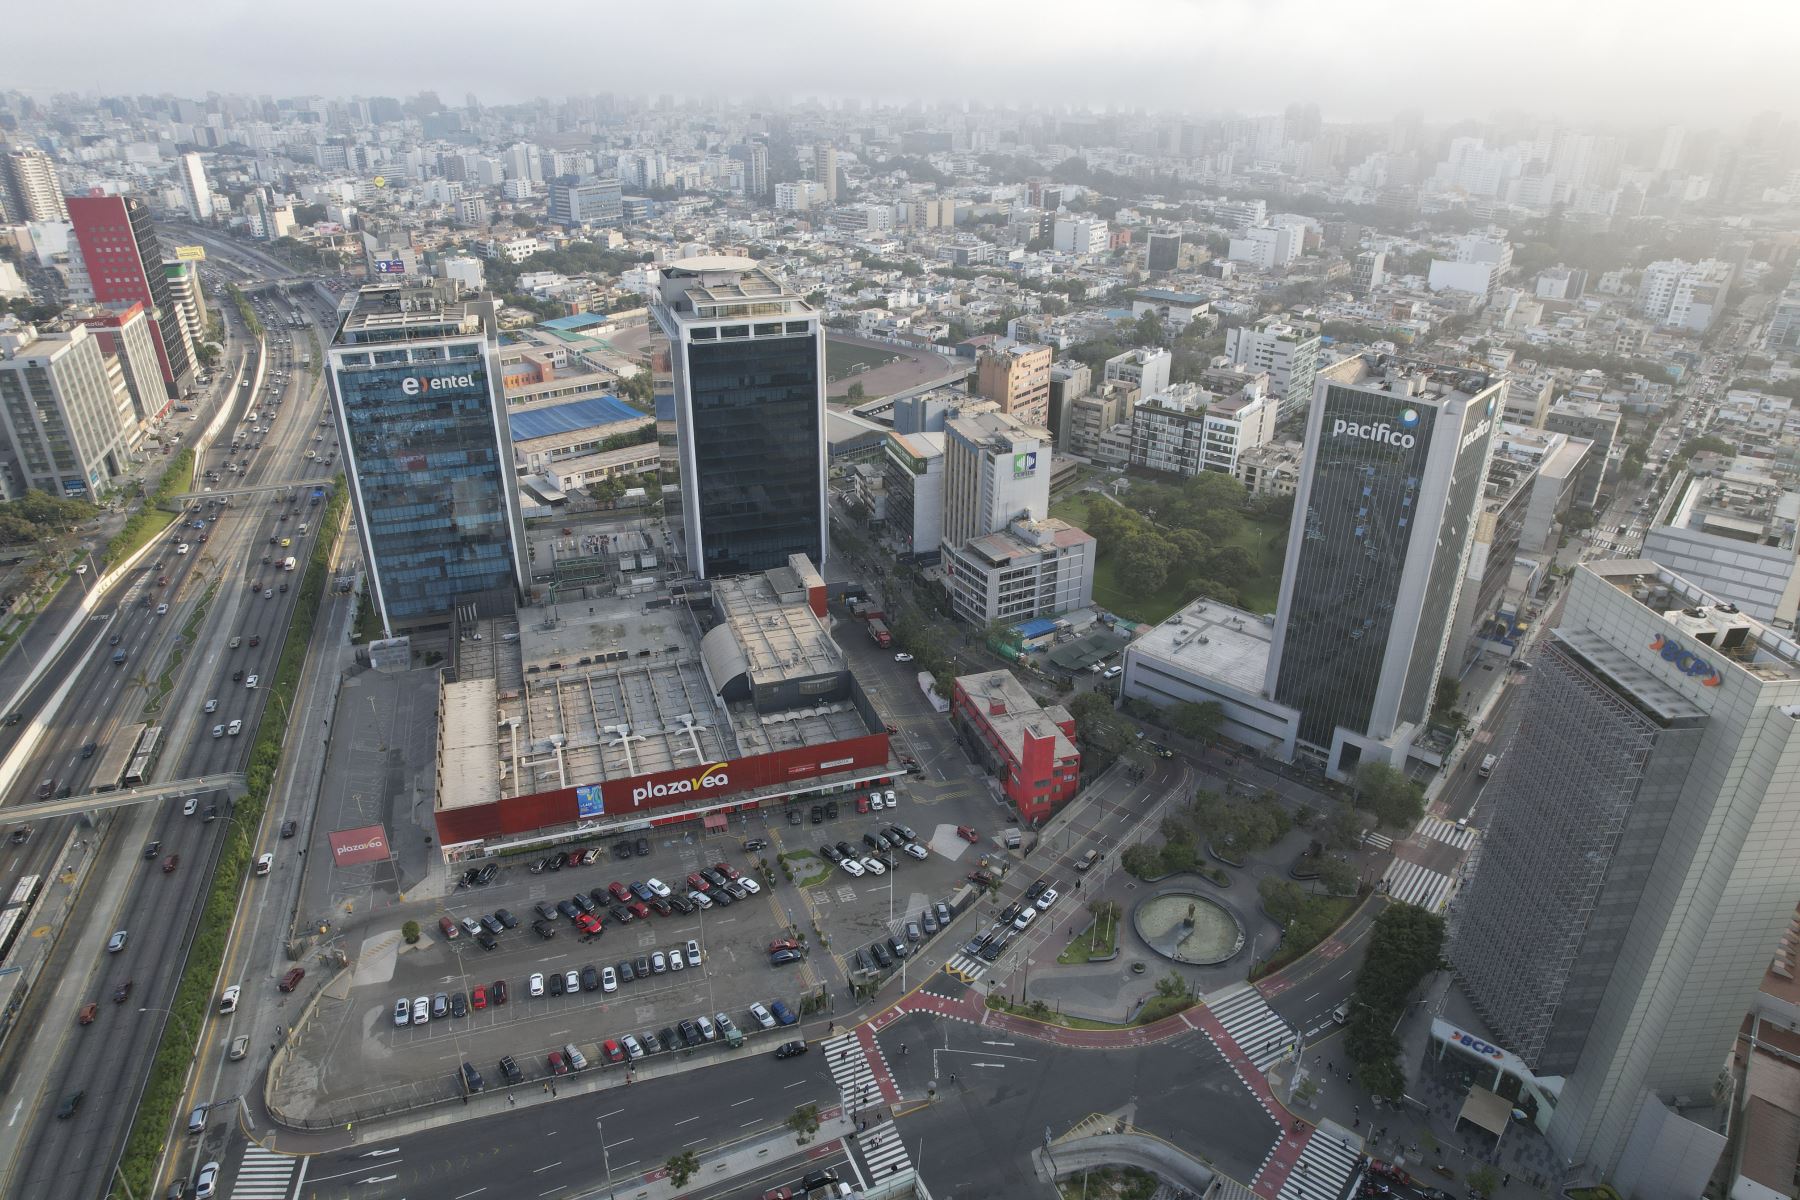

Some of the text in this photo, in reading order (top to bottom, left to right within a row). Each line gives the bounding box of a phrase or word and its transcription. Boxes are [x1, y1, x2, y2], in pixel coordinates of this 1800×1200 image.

[430, 374, 475, 390] entel
[1332, 418, 1415, 449] pacifico
[1460, 419, 1491, 455] pacifico
[1660, 639, 1711, 678] BCP
[632, 762, 729, 807] plazavea
[336, 836, 383, 856] plazavea
[1460, 1034, 1496, 1054] BCP
